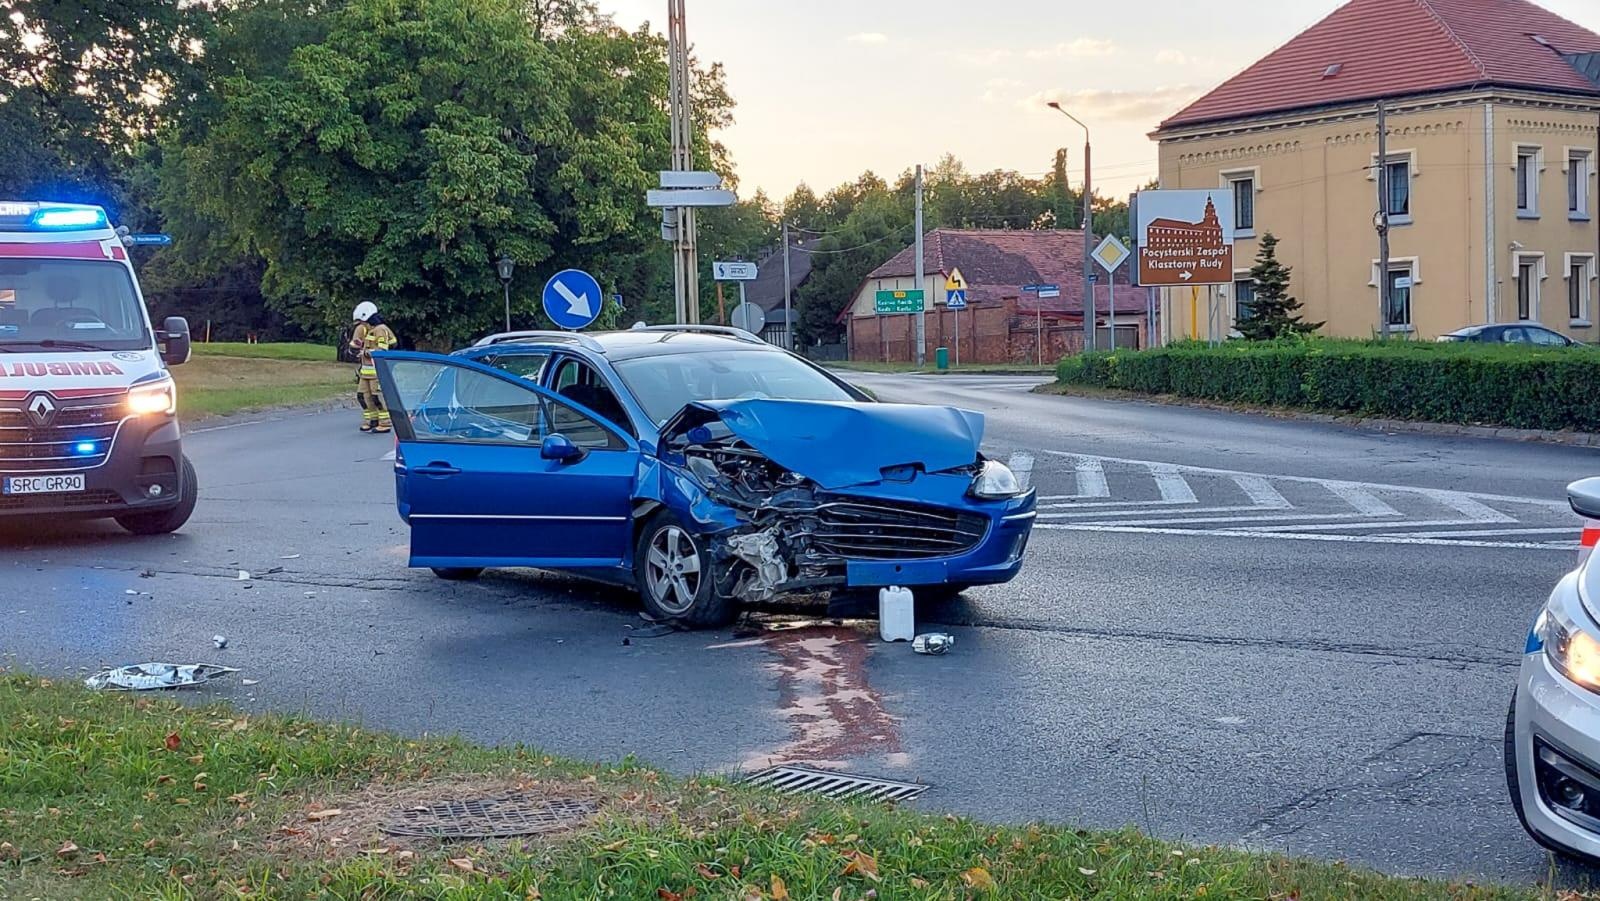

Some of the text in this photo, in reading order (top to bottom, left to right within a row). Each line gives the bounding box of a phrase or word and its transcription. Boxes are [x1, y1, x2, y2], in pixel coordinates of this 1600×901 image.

[1142, 247, 1194, 259] Pocysterski
[1148, 258, 1223, 270] Klasztorny Rudy
[13, 478, 41, 492] SRC
[46, 476, 81, 490] GR90
